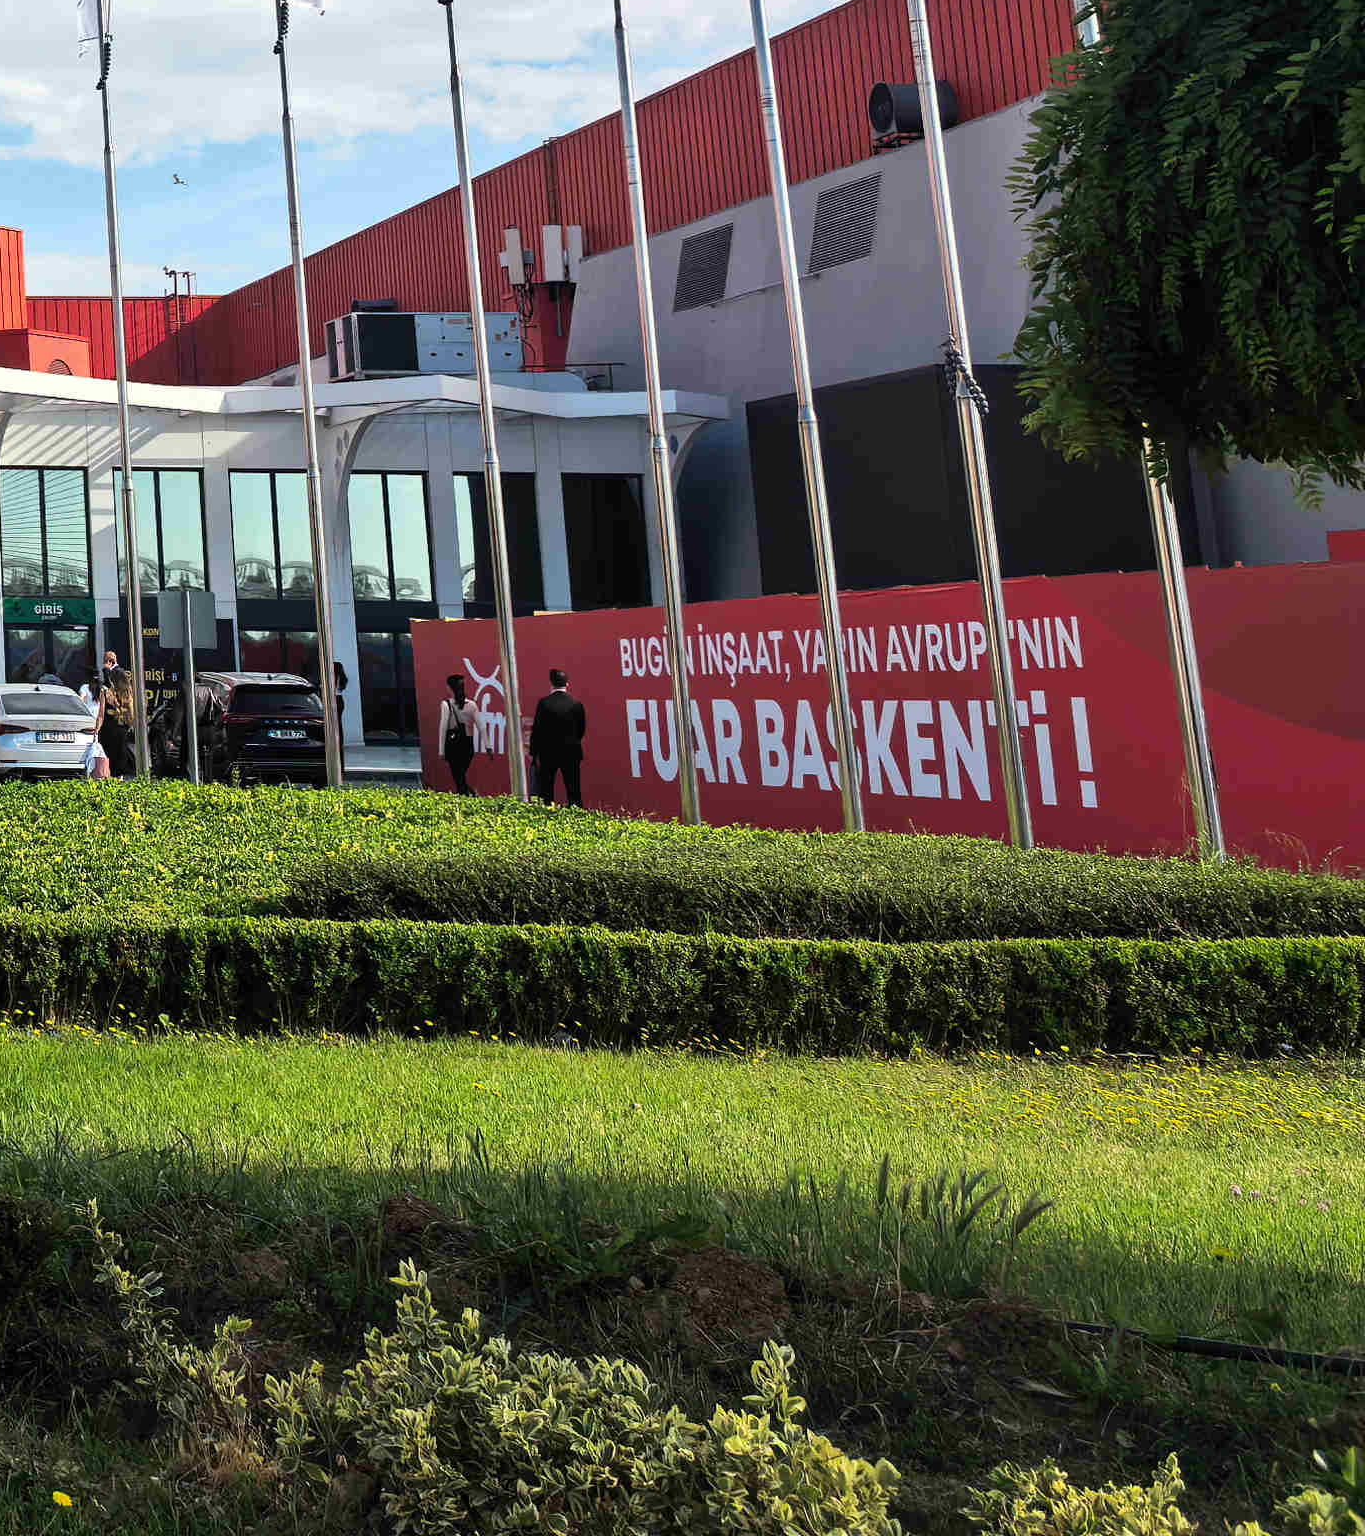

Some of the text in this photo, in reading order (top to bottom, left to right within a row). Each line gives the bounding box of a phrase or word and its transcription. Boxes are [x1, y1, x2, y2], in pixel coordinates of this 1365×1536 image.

[33, 603, 64, 616] GİRİŞ
[697, 623, 791, 687] İNŞAAT,
[886, 616, 1085, 673] AVRUP'NIN
[625, 699, 748, 785] FUAR
